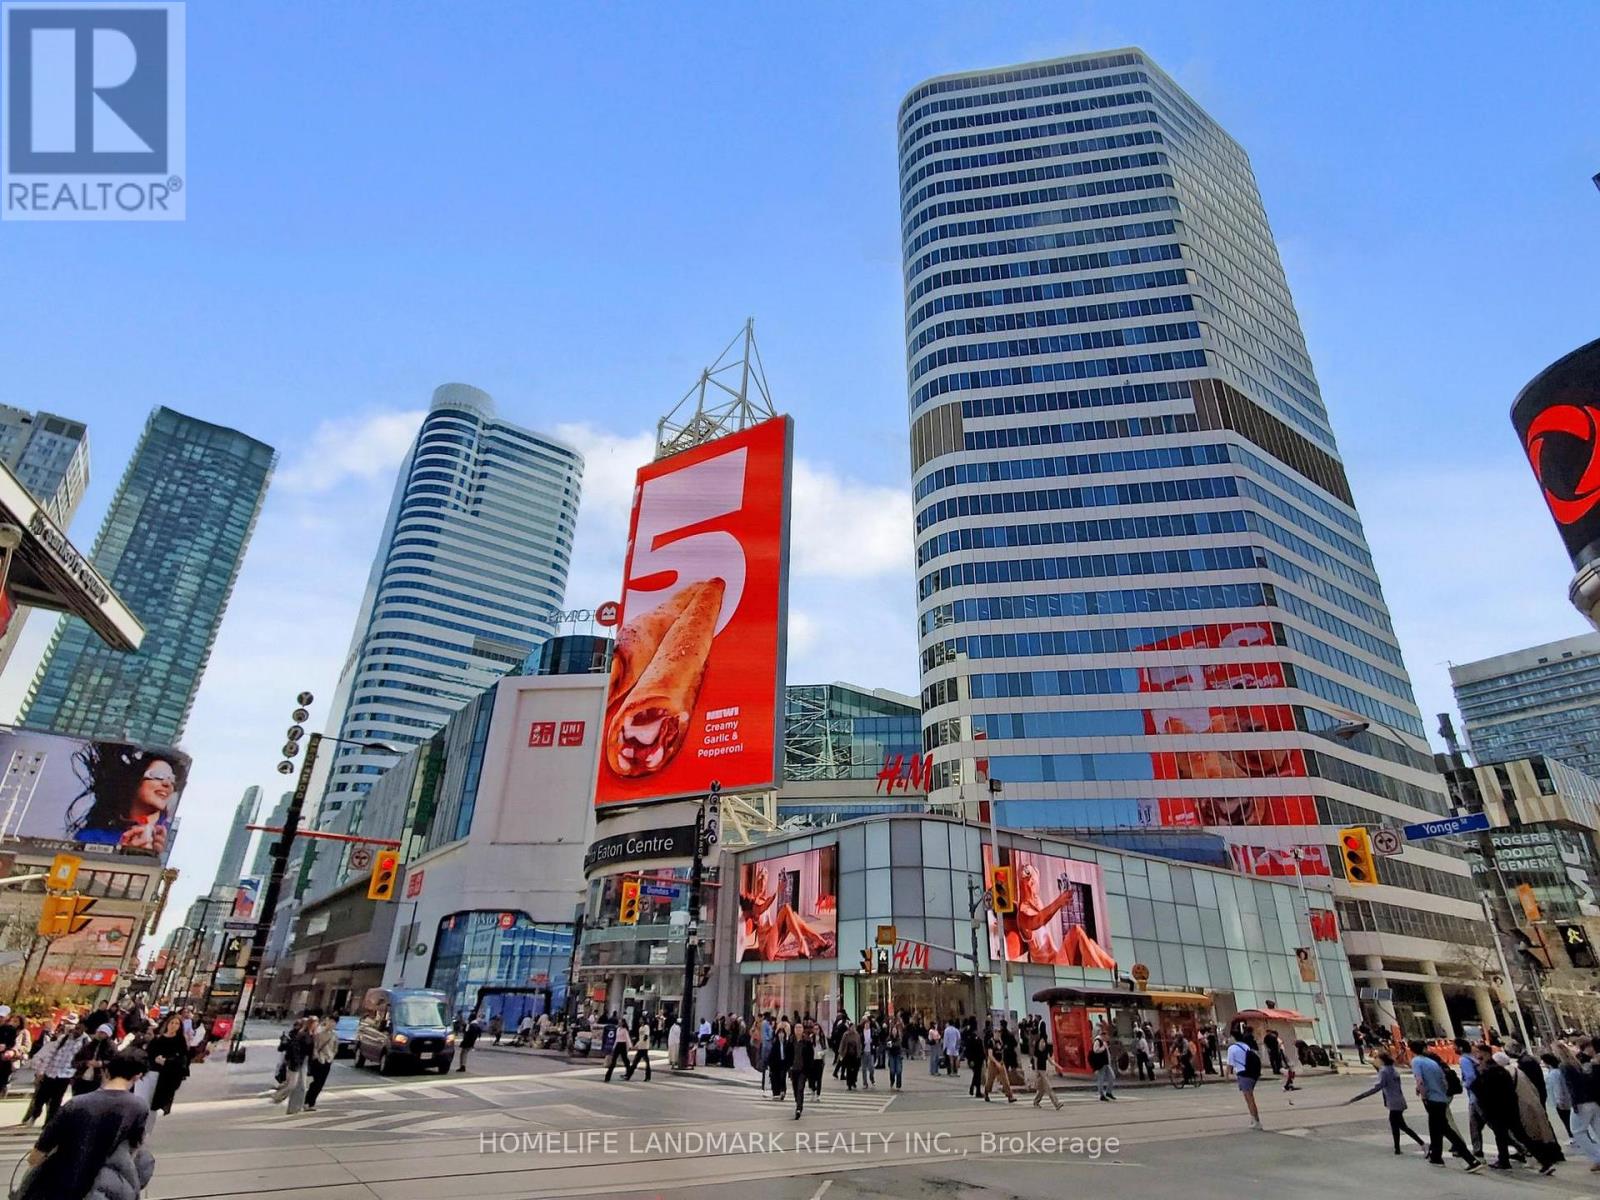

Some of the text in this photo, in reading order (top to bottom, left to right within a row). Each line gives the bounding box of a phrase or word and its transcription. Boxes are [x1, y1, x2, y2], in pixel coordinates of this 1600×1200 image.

[705, 720, 739, 732] Creamy
[703, 731, 738, 745] Garlic &
[697, 743, 744, 758] Pepperoni
[876, 753, 933, 795] H&M
[1422, 821, 1460, 835] Yonge
[1492, 832, 1550, 846] ROGERS
[597, 843, 623, 861] Eaton
[626, 837, 674, 854] Centre
[893, 940, 930, 971] H&M
